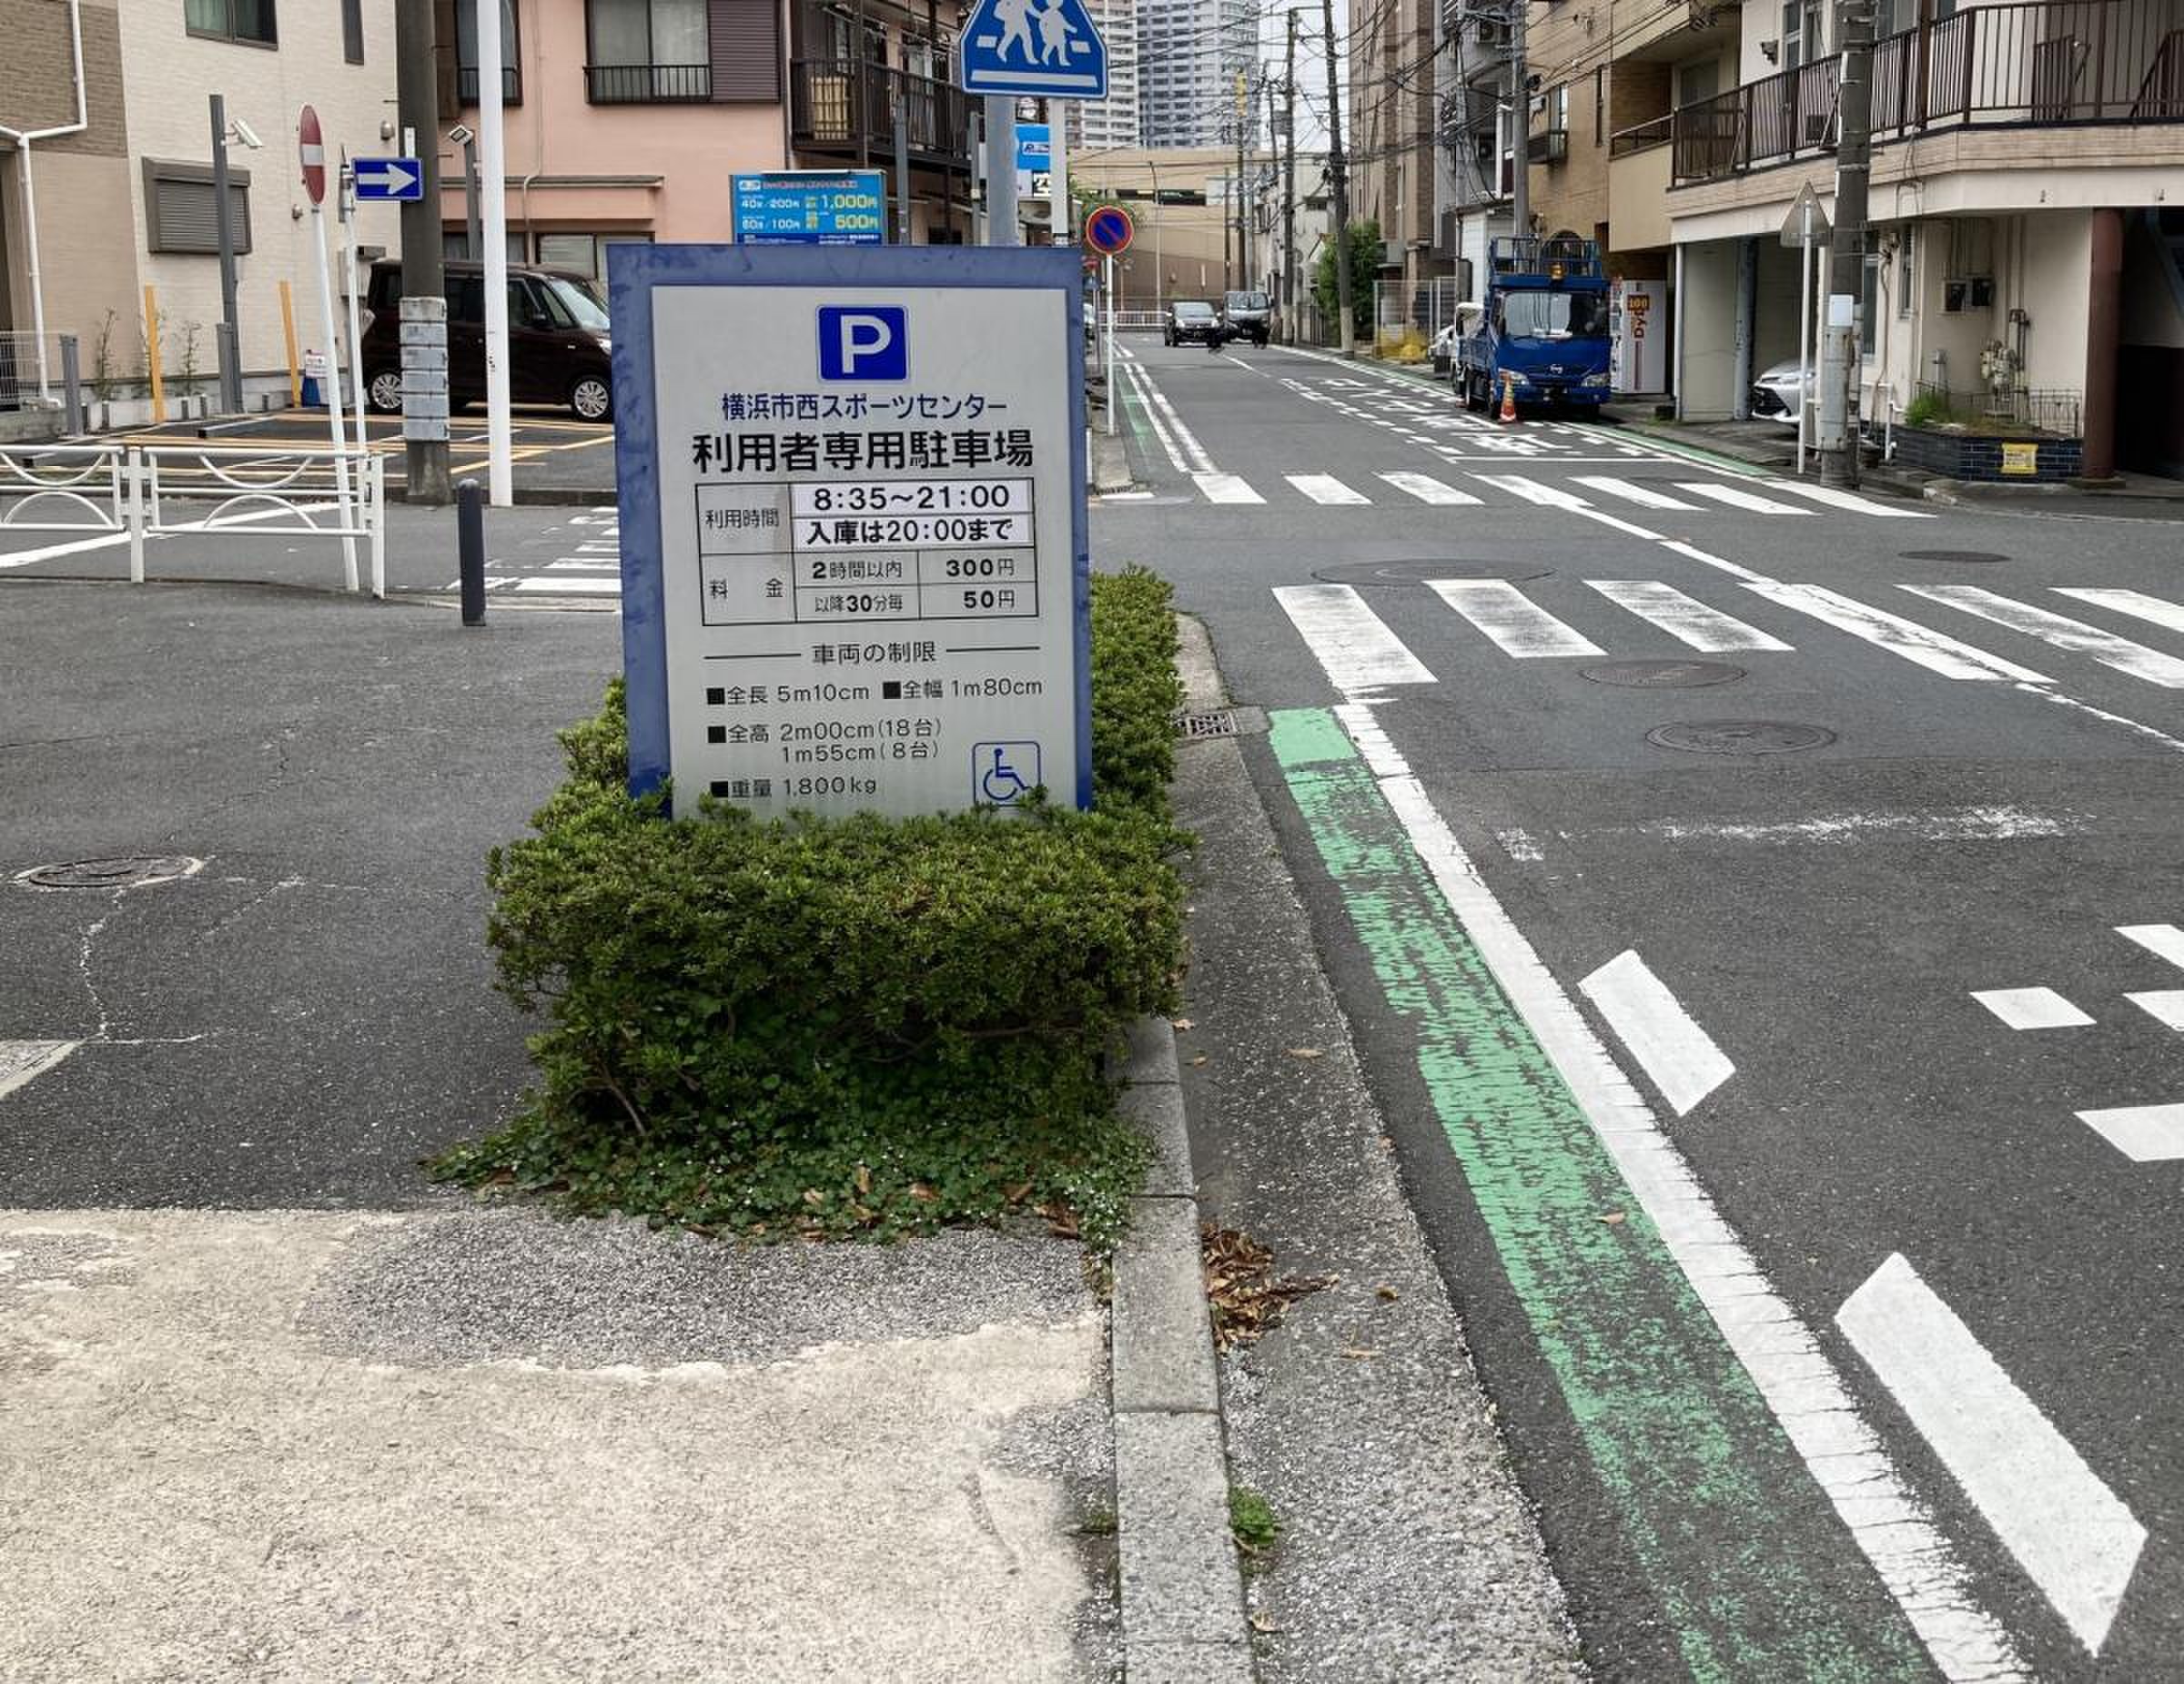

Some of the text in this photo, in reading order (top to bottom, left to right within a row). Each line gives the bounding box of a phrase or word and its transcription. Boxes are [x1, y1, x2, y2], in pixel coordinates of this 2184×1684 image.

[840, 315, 892, 374] P
[722, 393, 1006, 421] 横浜市西スポーツセンター
[692, 429, 1034, 473] 利用者専用駐車場
[705, 508, 780, 529] 利用時間
[807, 518, 1013, 545] 入庫は20:00まで
[813, 560, 903, 579] 2時間以内
[945, 558, 1015, 577] 300円
[814, 594, 903, 613] 以降30分毎
[964, 590, 1015, 609] 50円
[812, 641, 936, 665] 車両の制限
[777, 684, 870, 703] 5m10cm
[952, 678, 1042, 696] 1m80cm
